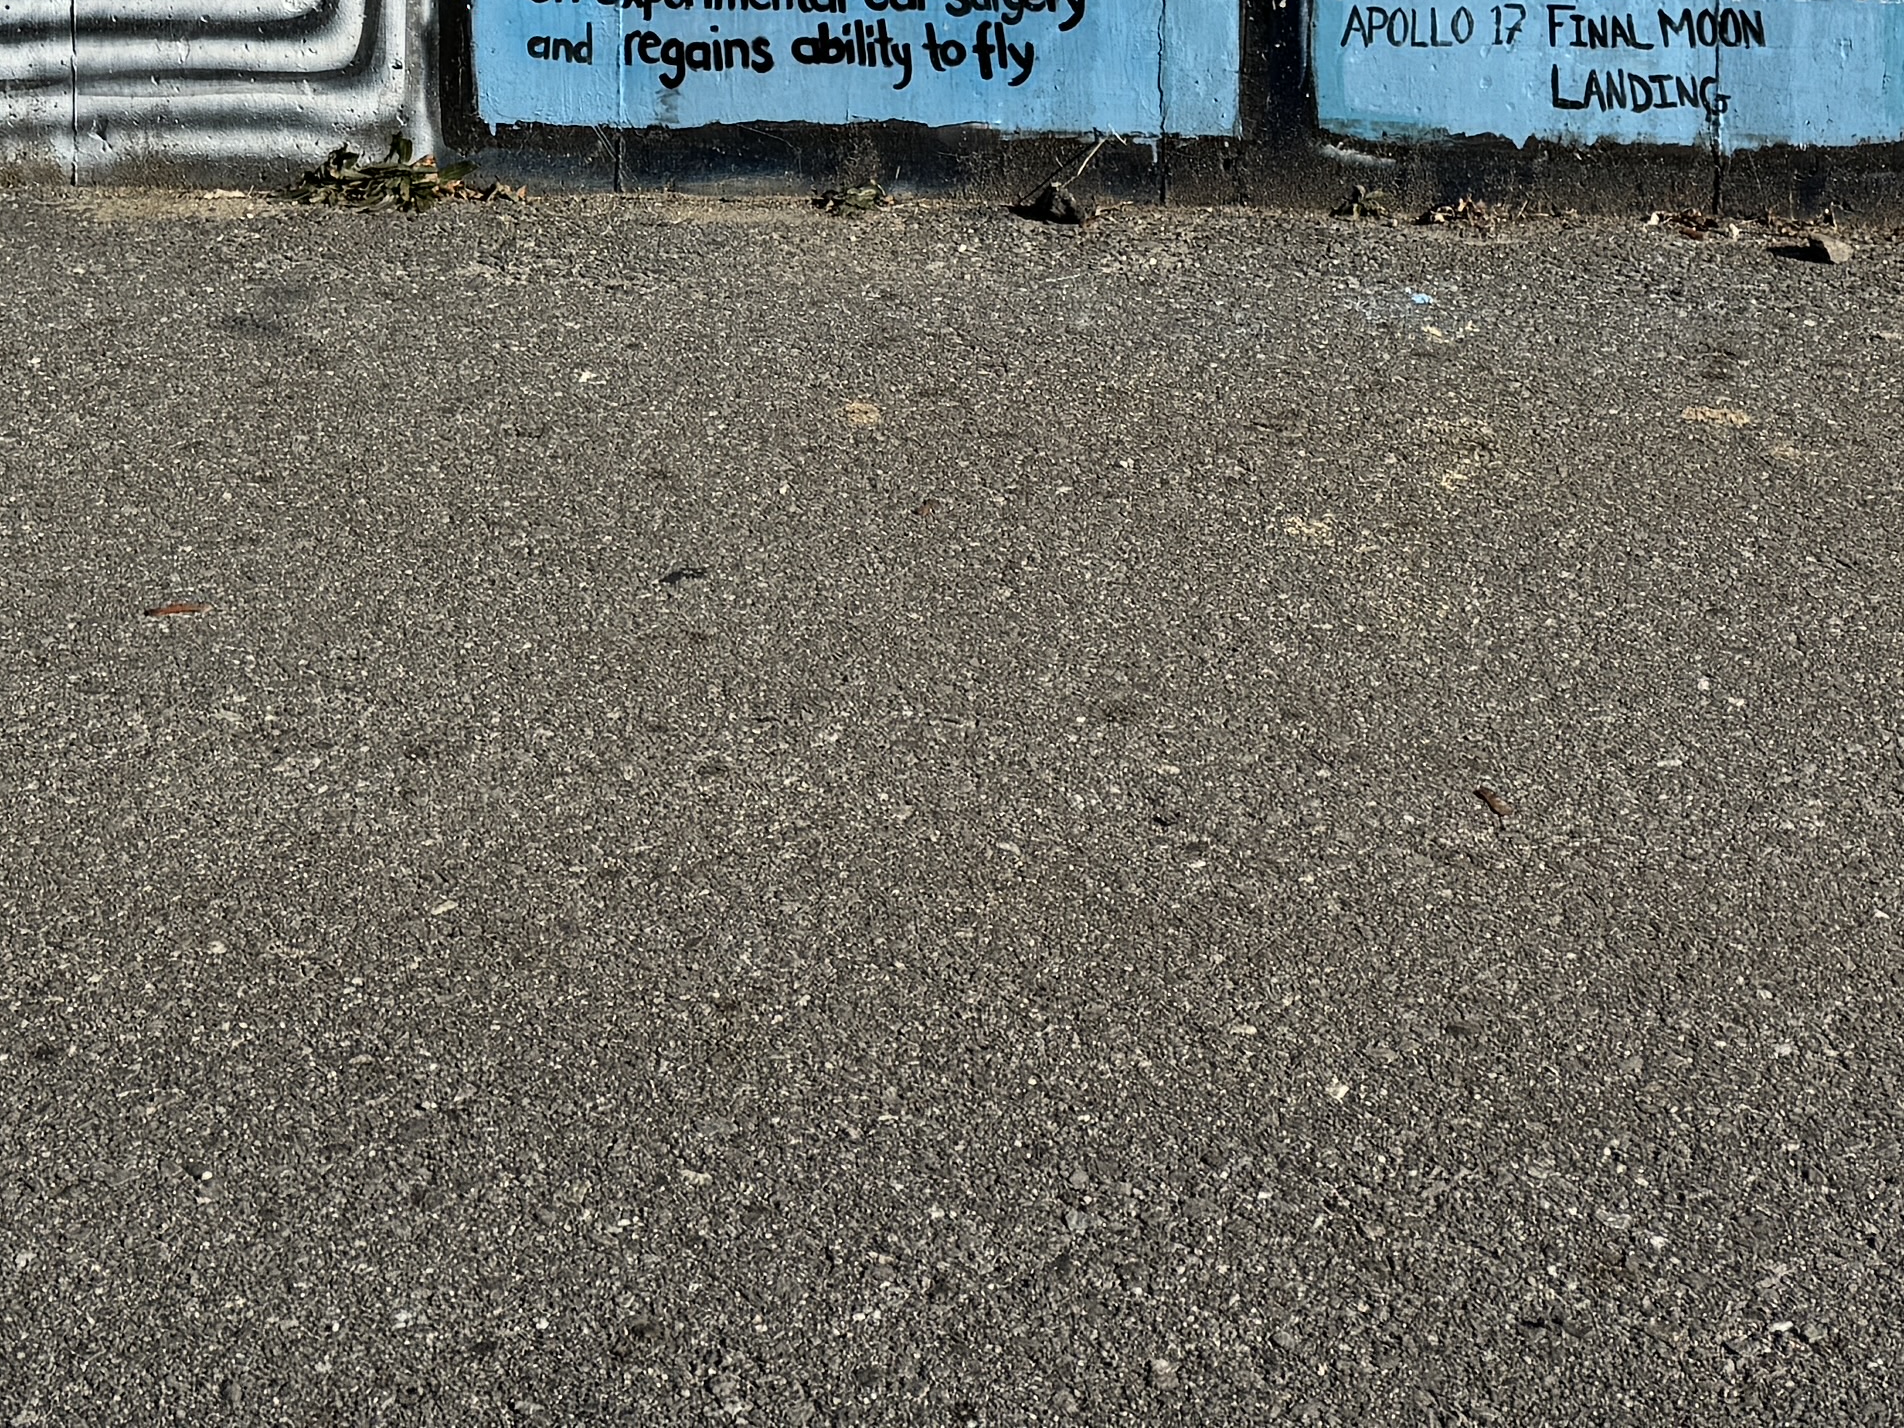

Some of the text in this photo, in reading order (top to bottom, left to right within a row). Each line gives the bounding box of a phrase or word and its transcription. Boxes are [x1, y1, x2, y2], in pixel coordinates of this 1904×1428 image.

[1341, 3, 1766, 49] APOLLO 17 FINAL MOON
[527, 18, 1035, 90] and regains ability to fly
[1551, 64, 1731, 116] LANDING
